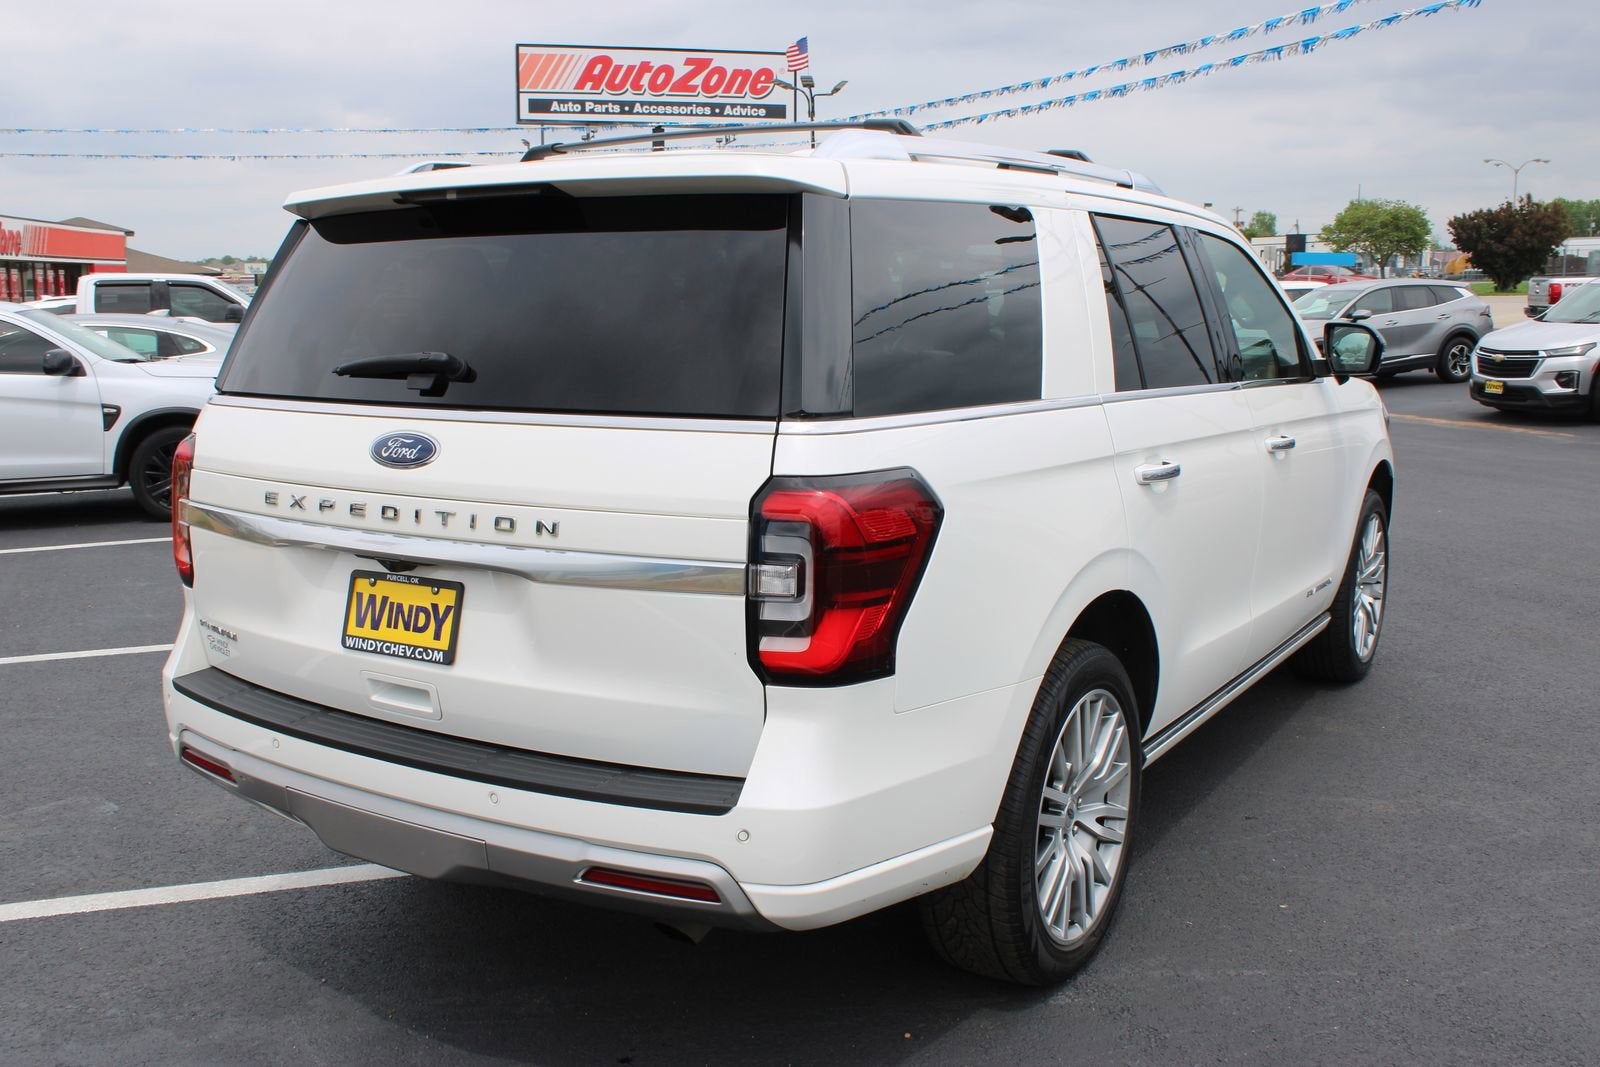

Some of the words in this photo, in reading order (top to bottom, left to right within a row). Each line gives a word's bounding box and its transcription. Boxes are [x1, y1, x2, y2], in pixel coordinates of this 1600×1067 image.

[573, 54, 775, 97] AutoZone
[550, 101, 581, 113] Auto
[585, 102, 620, 113] Parts
[633, 102, 711, 115] Accessories
[723, 104, 766, 117] Advice
[381, 437, 422, 459] Ford
[264, 491, 560, 537] EXPEDITION
[345, 636, 444, 663] WINDYCHEV.COM
